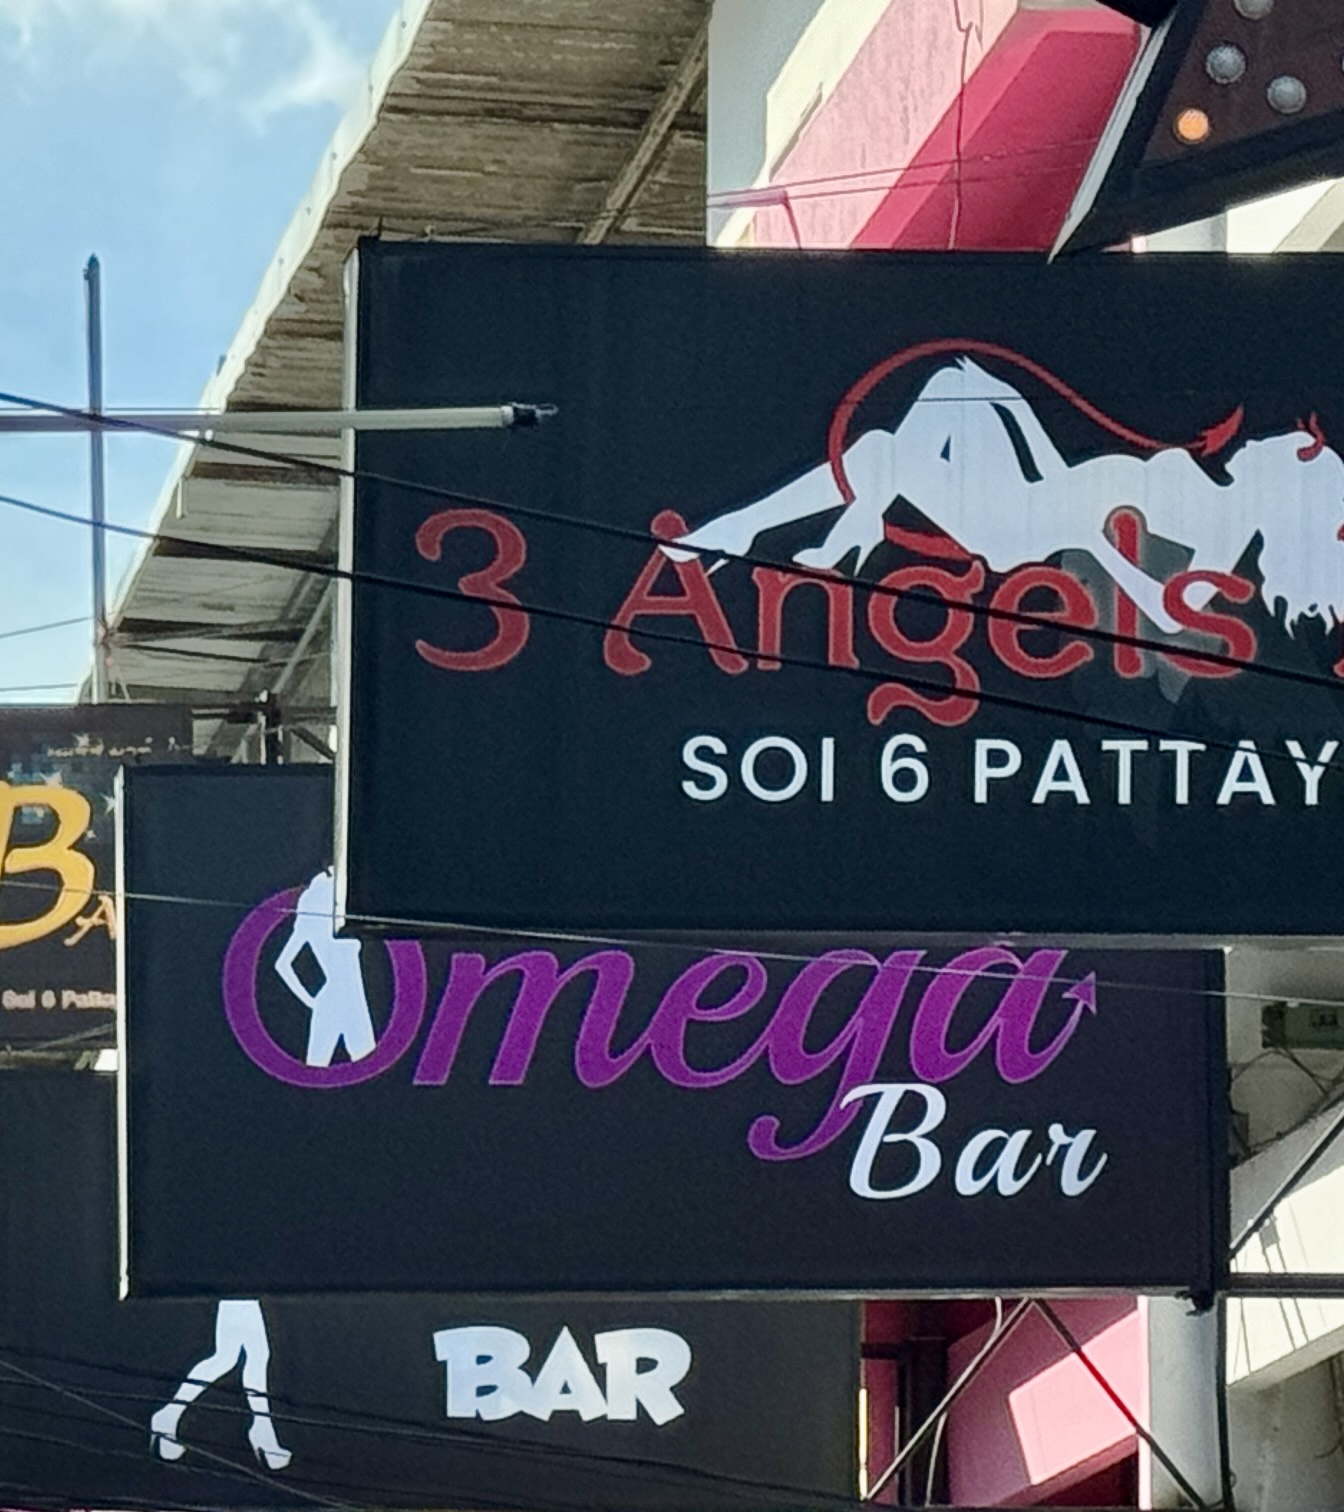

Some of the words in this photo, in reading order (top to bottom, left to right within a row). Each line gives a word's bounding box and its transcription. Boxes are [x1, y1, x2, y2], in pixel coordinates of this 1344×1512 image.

[415, 508, 531, 674] 3
[602, 506, 1257, 725] Angels
[682, 737, 835, 803] SOI
[882, 734, 929, 803] 6
[974, 738, 1340, 806] PATTAY
[224, 885, 1096, 1160] Omega
[840, 1083, 1108, 1200] Bar
[434, 1326, 692, 1426] BAR
